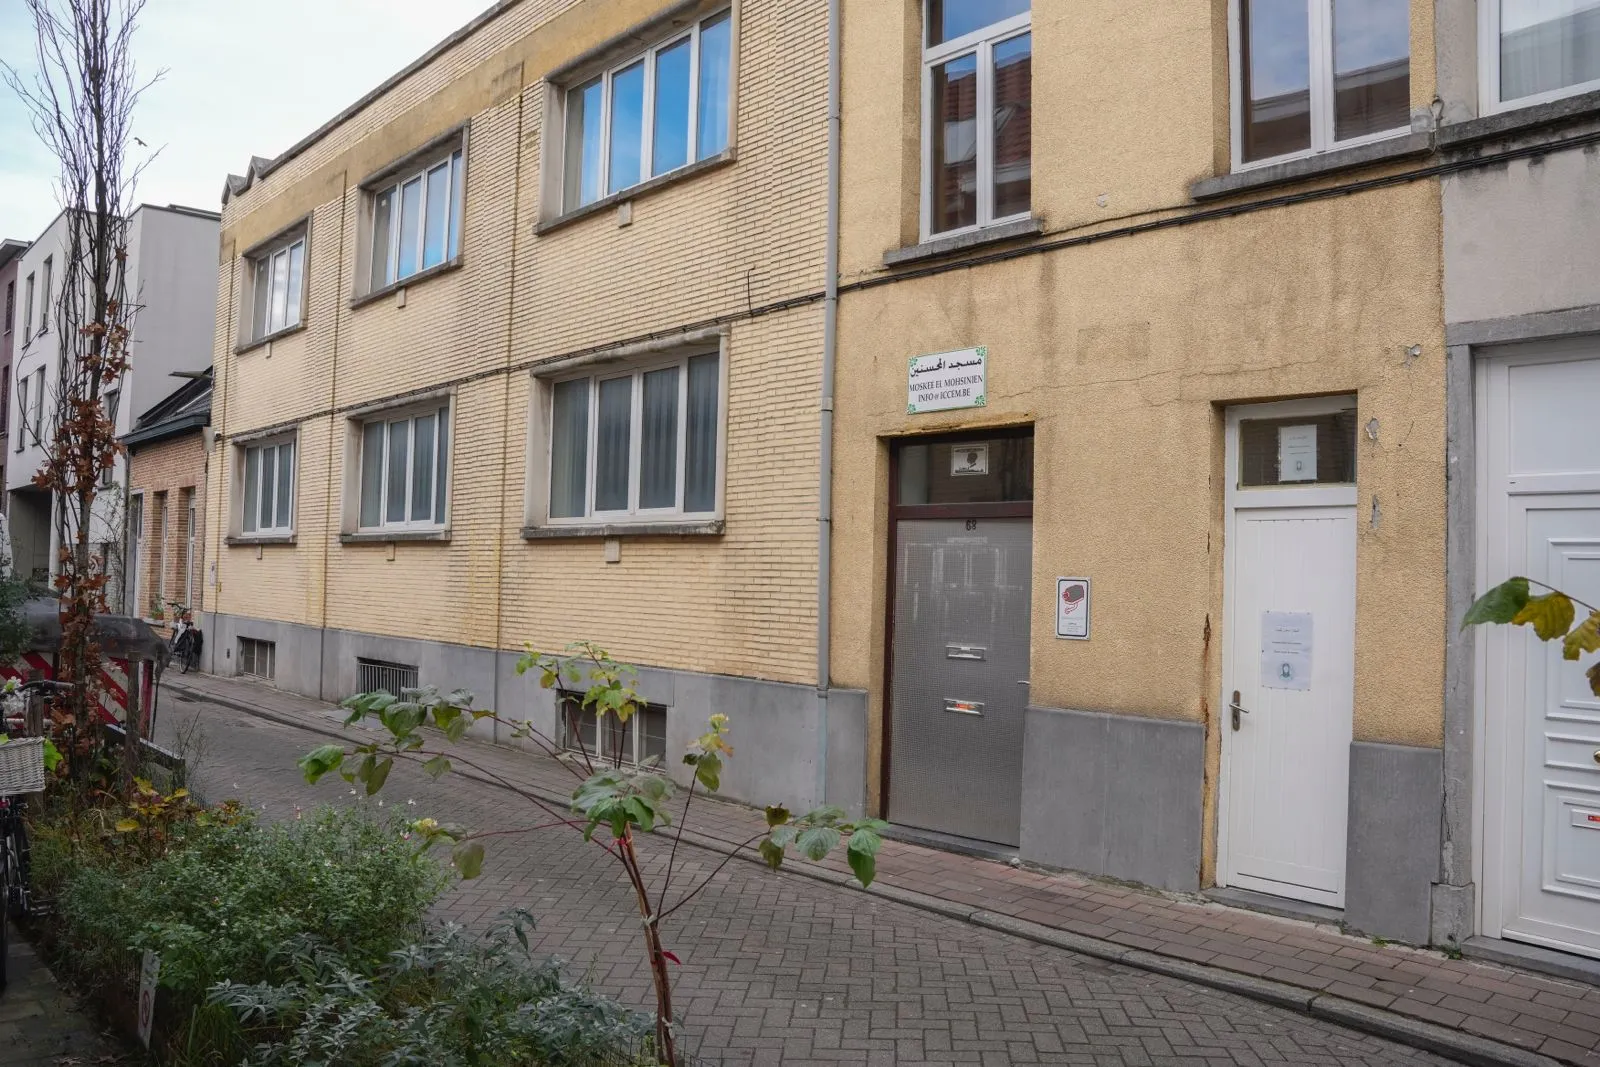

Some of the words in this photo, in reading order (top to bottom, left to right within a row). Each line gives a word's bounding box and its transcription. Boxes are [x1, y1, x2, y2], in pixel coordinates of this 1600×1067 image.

[948, 358, 982, 370] مسجد
[910, 381, 935, 392] MOSKEE
[936, 380, 943, 389] EL
[966, 519, 977, 531] 68
